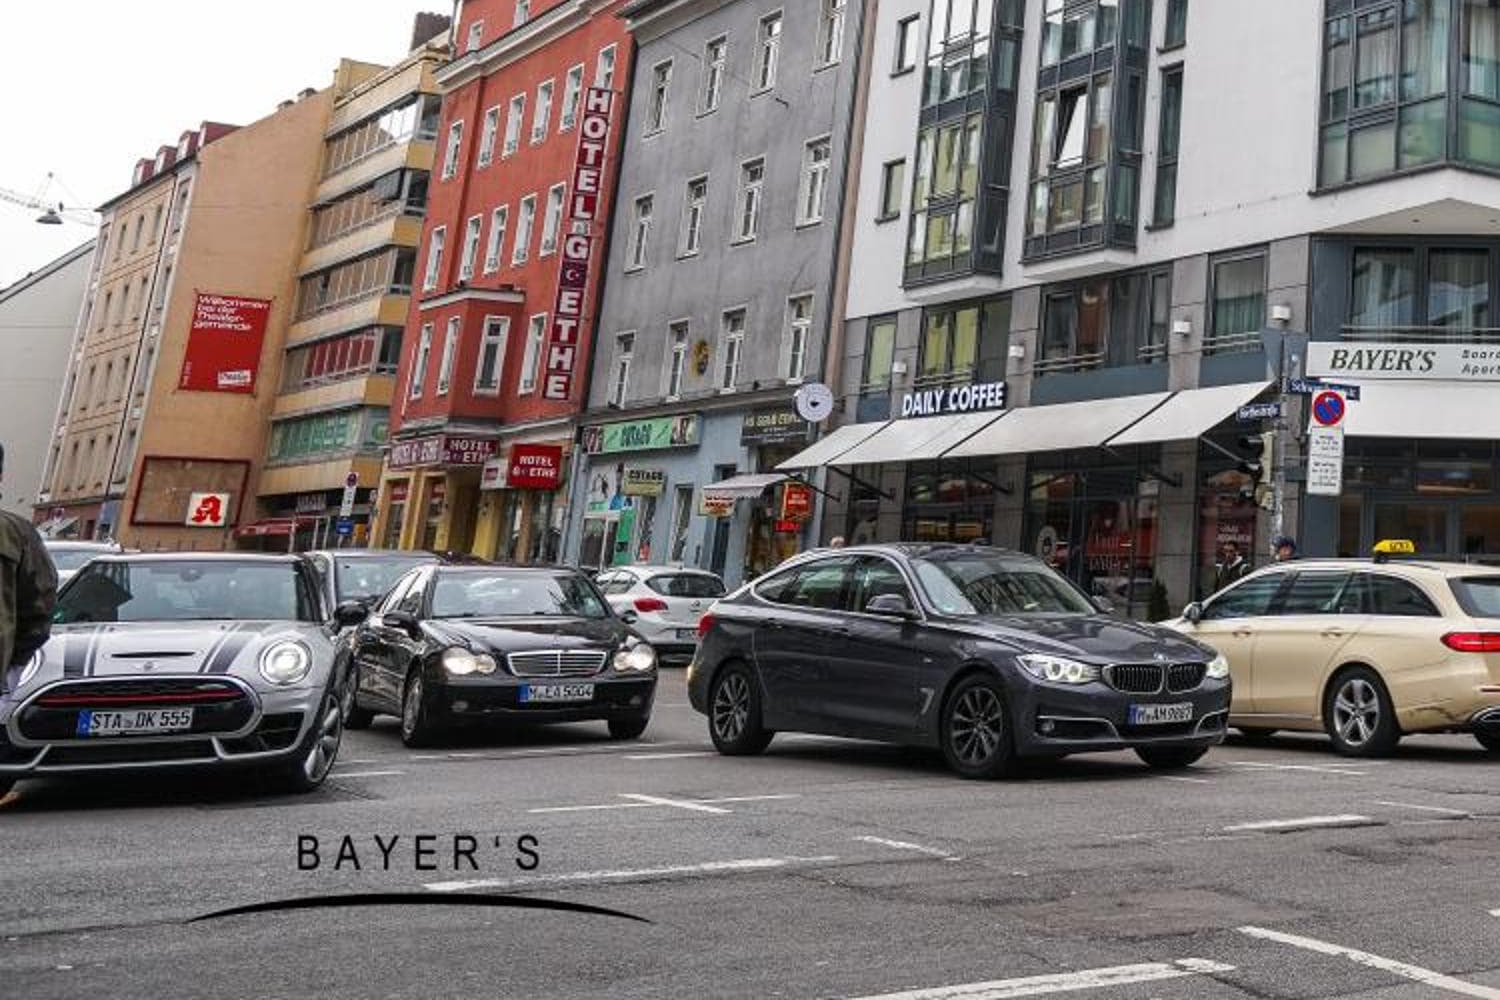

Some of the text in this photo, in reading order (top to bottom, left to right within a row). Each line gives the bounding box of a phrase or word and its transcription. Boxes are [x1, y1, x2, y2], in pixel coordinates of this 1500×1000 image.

[573, 88, 610, 219] HOTEL
[1330, 349, 1437, 373] BAYER'S
[902, 382, 1005, 417] DAILY COFFEE
[450, 439, 492, 452] HOTEL
[519, 455, 553, 467] HOTEL
[90, 709, 191, 730] STA DK 555
